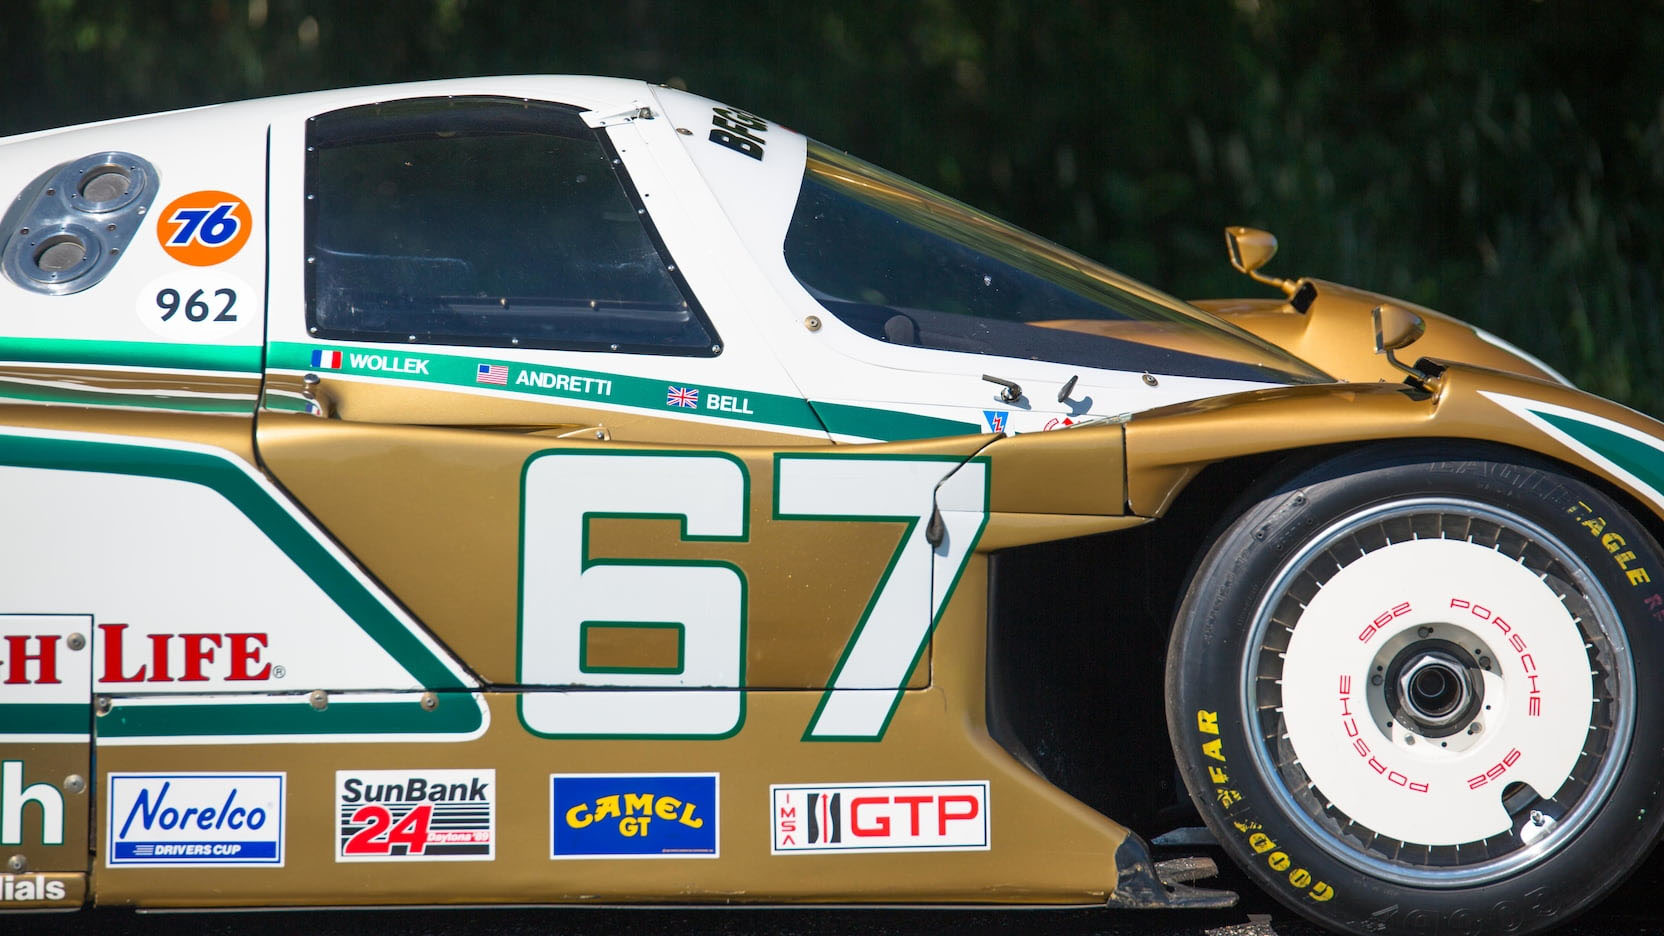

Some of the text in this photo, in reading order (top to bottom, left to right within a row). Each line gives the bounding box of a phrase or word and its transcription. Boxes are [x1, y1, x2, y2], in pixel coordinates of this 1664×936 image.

[708, 106, 768, 162] BFG
[165, 202, 240, 246] 76
[156, 288, 237, 322] 962
[350, 353, 429, 375] WOLLEK
[515, 370, 612, 397] ANDRETTI
[706, 394, 754, 415] BELL
[516, 448, 991, 742] 67
[1358, 601, 1412, 644] 962
[0, 623, 272, 684] H LIFE
[1450, 598, 1541, 717] PORSCHE
[1339, 675, 1430, 793] PORSCHE
[341, 777, 489, 803] SunBank
[1467, 748, 1522, 790] 962
[119, 781, 266, 840] Norelco
[344, 804, 433, 854] 24
[565, 792, 704, 829] CAMEL
[618, 816, 652, 838] GT
[780, 793, 796, 846] IMSA
[850, 795, 980, 838] GTP
[154, 844, 242, 856] DRIVERS CUP
[427, 832, 471, 843] Daytona
